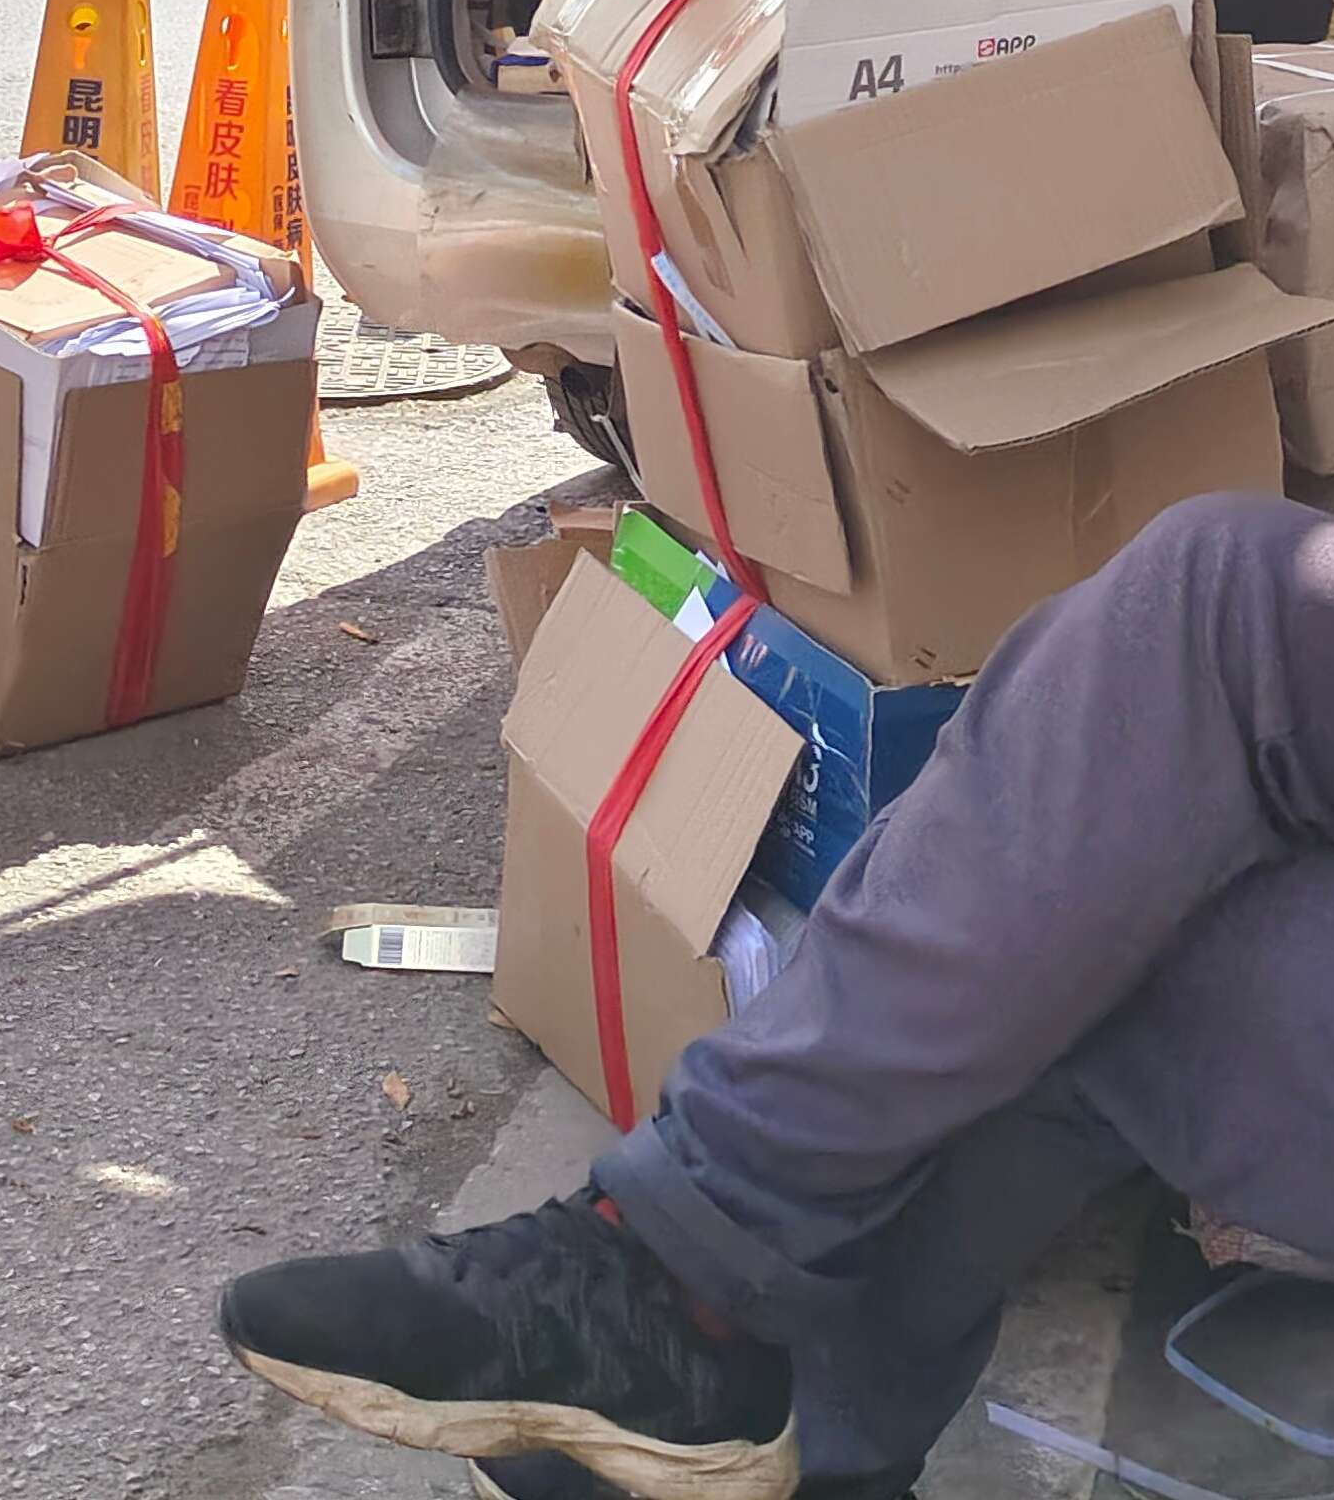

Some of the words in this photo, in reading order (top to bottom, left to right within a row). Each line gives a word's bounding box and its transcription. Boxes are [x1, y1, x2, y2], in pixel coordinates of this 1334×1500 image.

[996, 34, 1036, 55] APP
[849, 54, 904, 101] A4
[63, 78, 103, 160] 昆明
